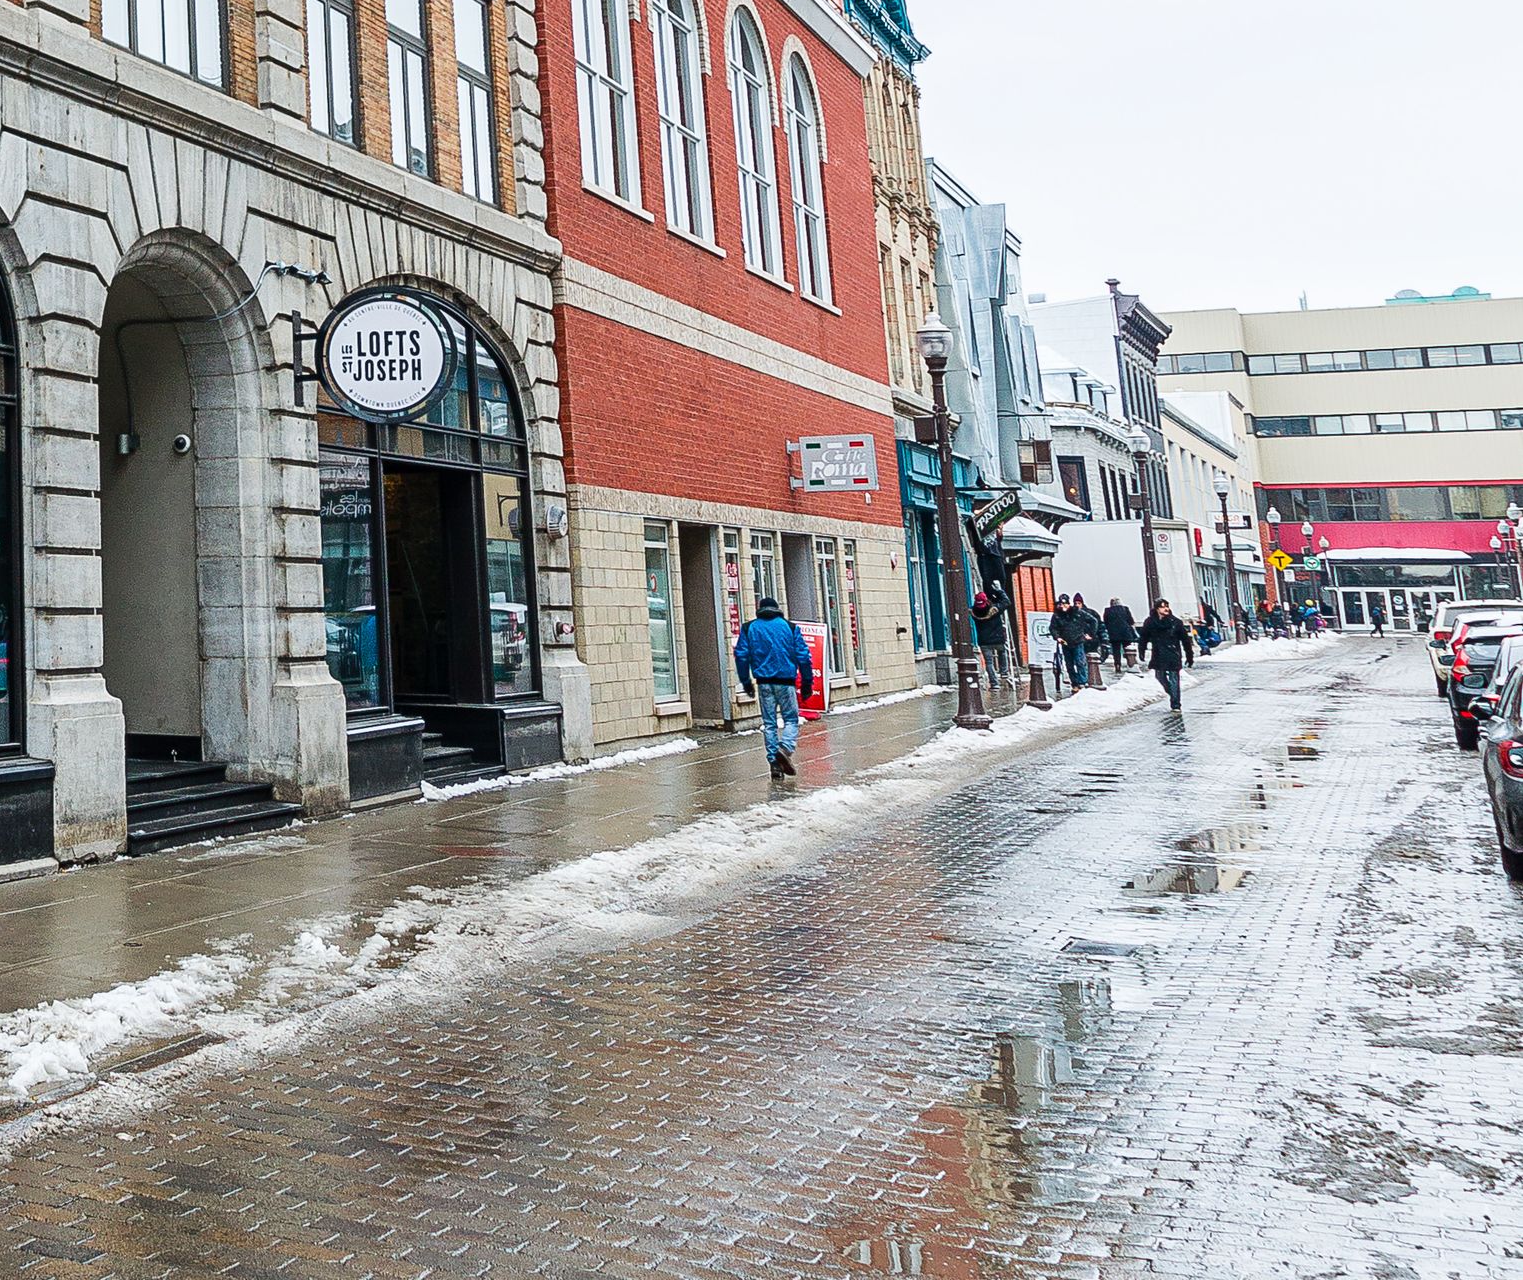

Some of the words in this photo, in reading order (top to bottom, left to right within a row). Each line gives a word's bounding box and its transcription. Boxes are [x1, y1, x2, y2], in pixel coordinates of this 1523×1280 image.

[341, 345, 353, 354] LES
[356, 330, 421, 357] LOFTS
[342, 361, 353, 374] ST
[353, 358, 422, 382] JOSEPH
[353, 392, 385, 408] DOWNTOWN
[409, 391, 422, 403] CITY
[811, 461, 867, 480] Roma
[976, 492, 1016, 531] TATTOO
